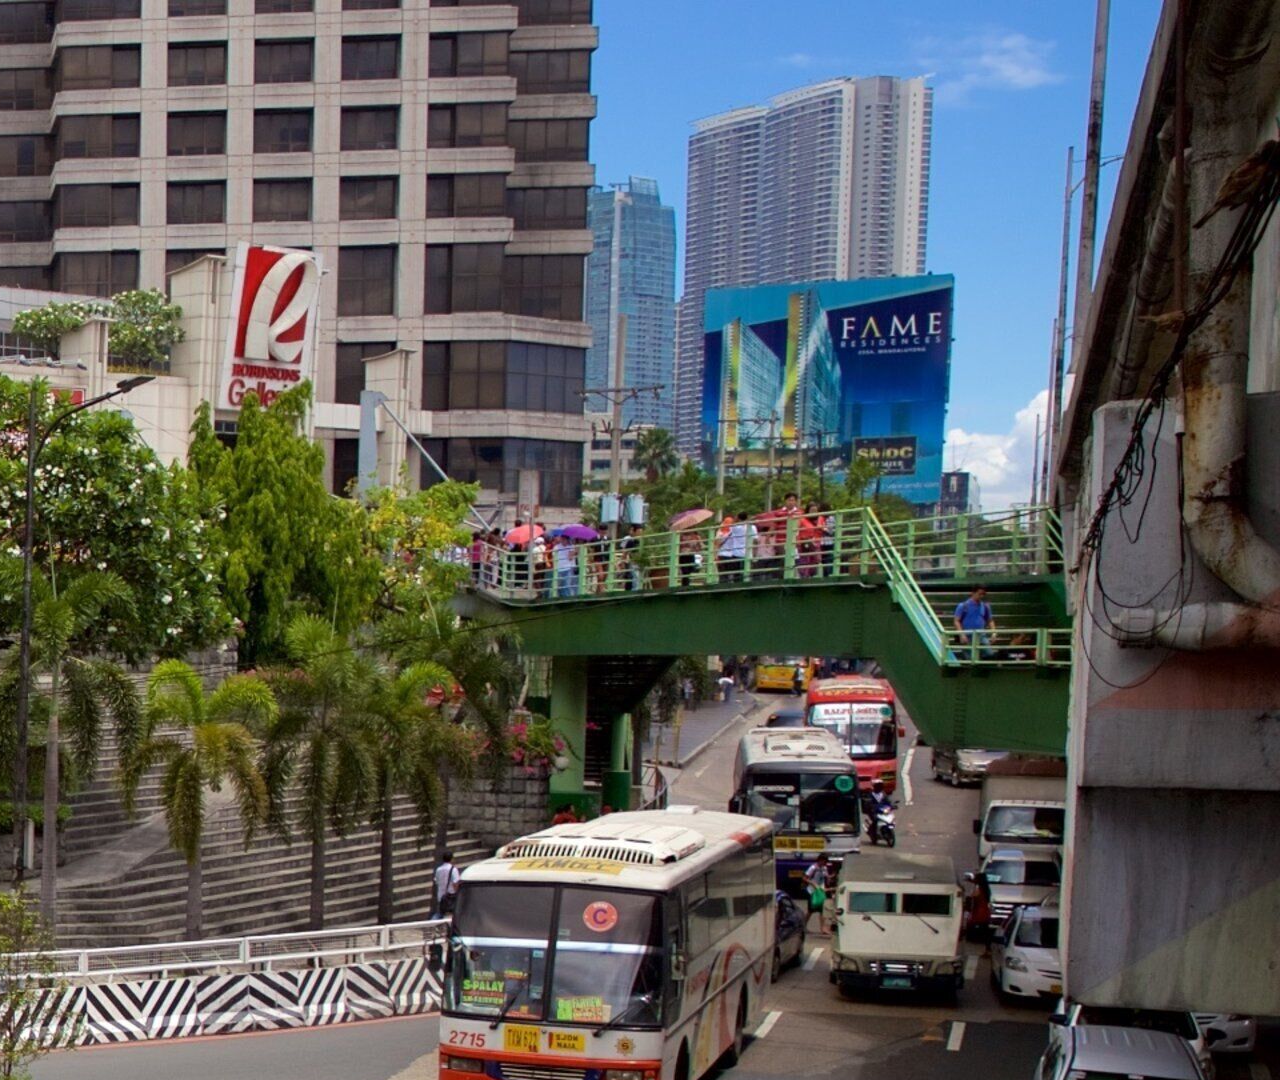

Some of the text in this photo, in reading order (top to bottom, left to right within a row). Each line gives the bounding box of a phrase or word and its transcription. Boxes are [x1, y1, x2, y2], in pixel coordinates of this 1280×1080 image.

[842, 312, 942, 339] FAME
[840, 336, 940, 348] RESIDENCES
[232, 363, 301, 381] ROBINSONS
[592, 908, 608, 925] C
[449, 1030, 486, 1048] 2715
